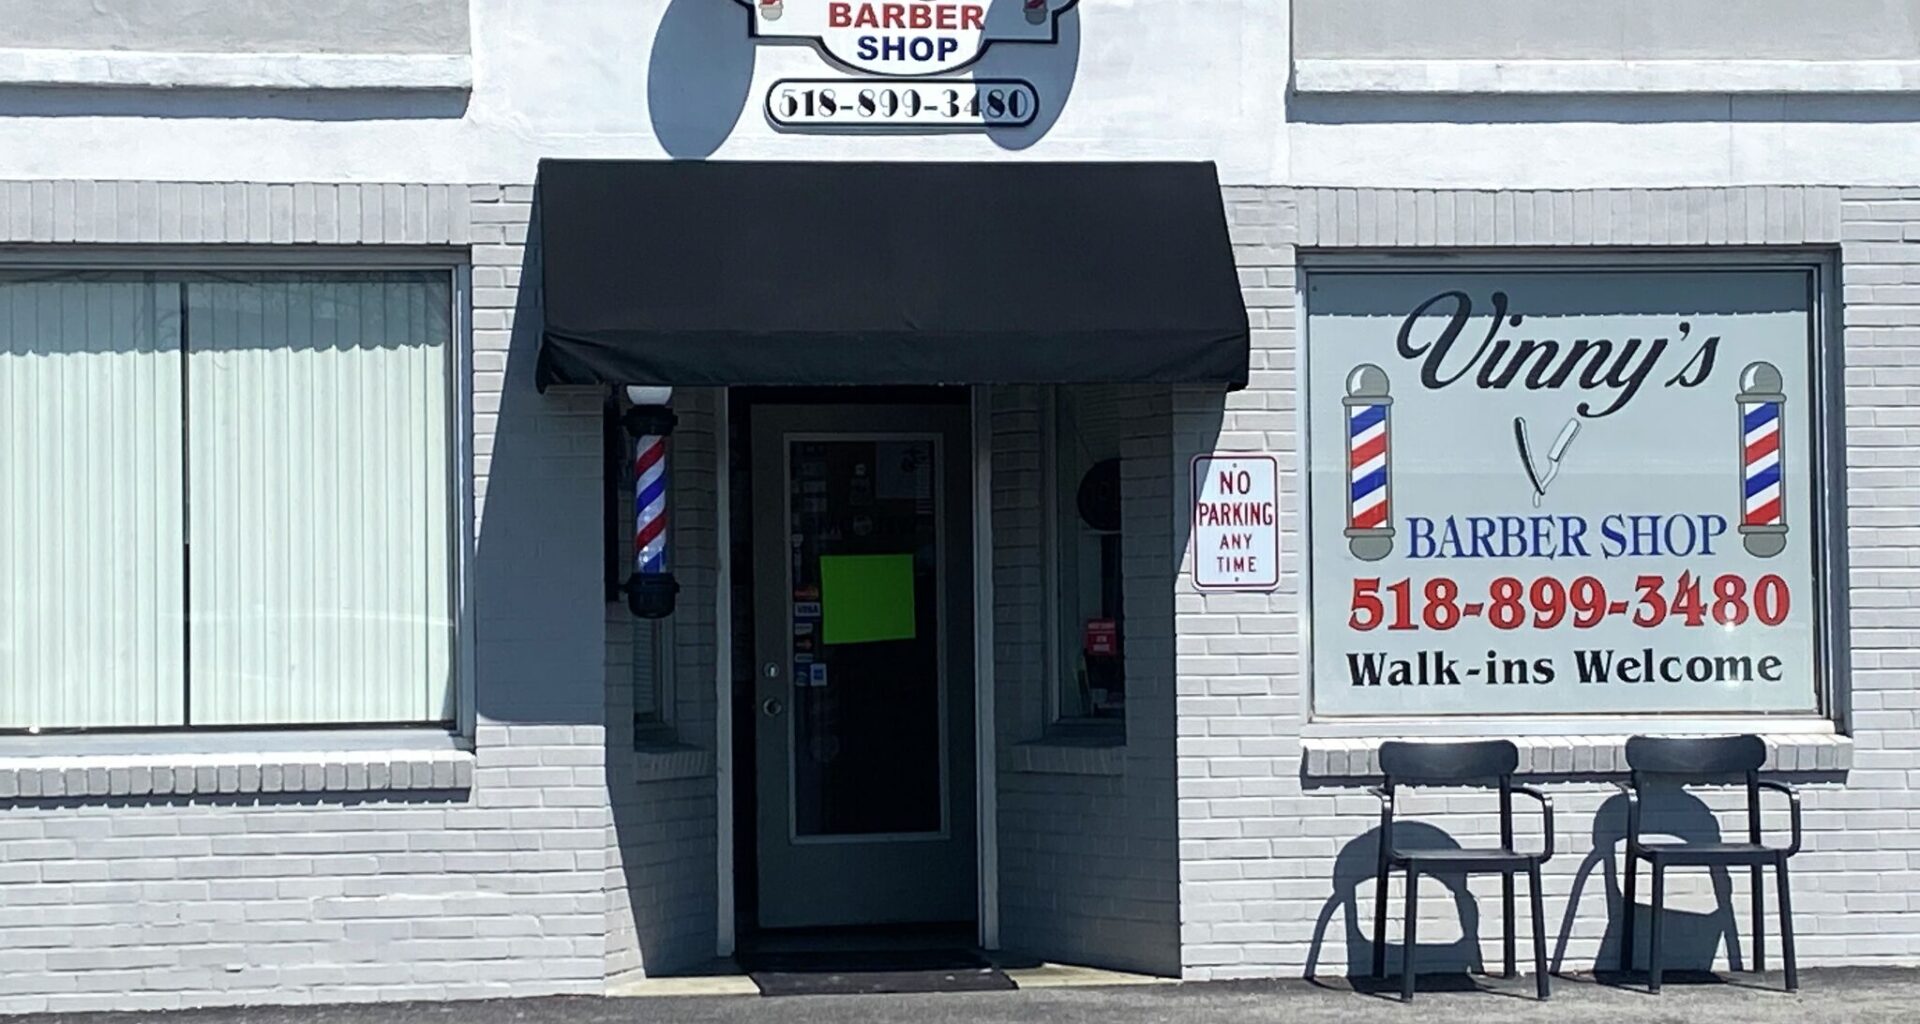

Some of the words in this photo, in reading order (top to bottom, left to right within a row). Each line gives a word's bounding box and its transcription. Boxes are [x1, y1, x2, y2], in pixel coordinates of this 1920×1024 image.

[828, 2, 985, 30] BARBER
[856, 36, 958, 62] SHOP
[779, 88, 1028, 118] 518-899-3480
[1397, 290, 1720, 418] Vinny's
[1219, 470, 1251, 495] NO
[1198, 502, 1273, 526] PARKING
[1219, 533, 1253, 550] ANY
[1406, 514, 1591, 560] BARBER
[1600, 513, 1727, 558] SHOP
[1216, 556, 1257, 573] TIME
[1347, 570, 1790, 631] 518-899-3480
[1346, 650, 1555, 686] Walk-ins
[1574, 648, 1783, 684] Welcome
